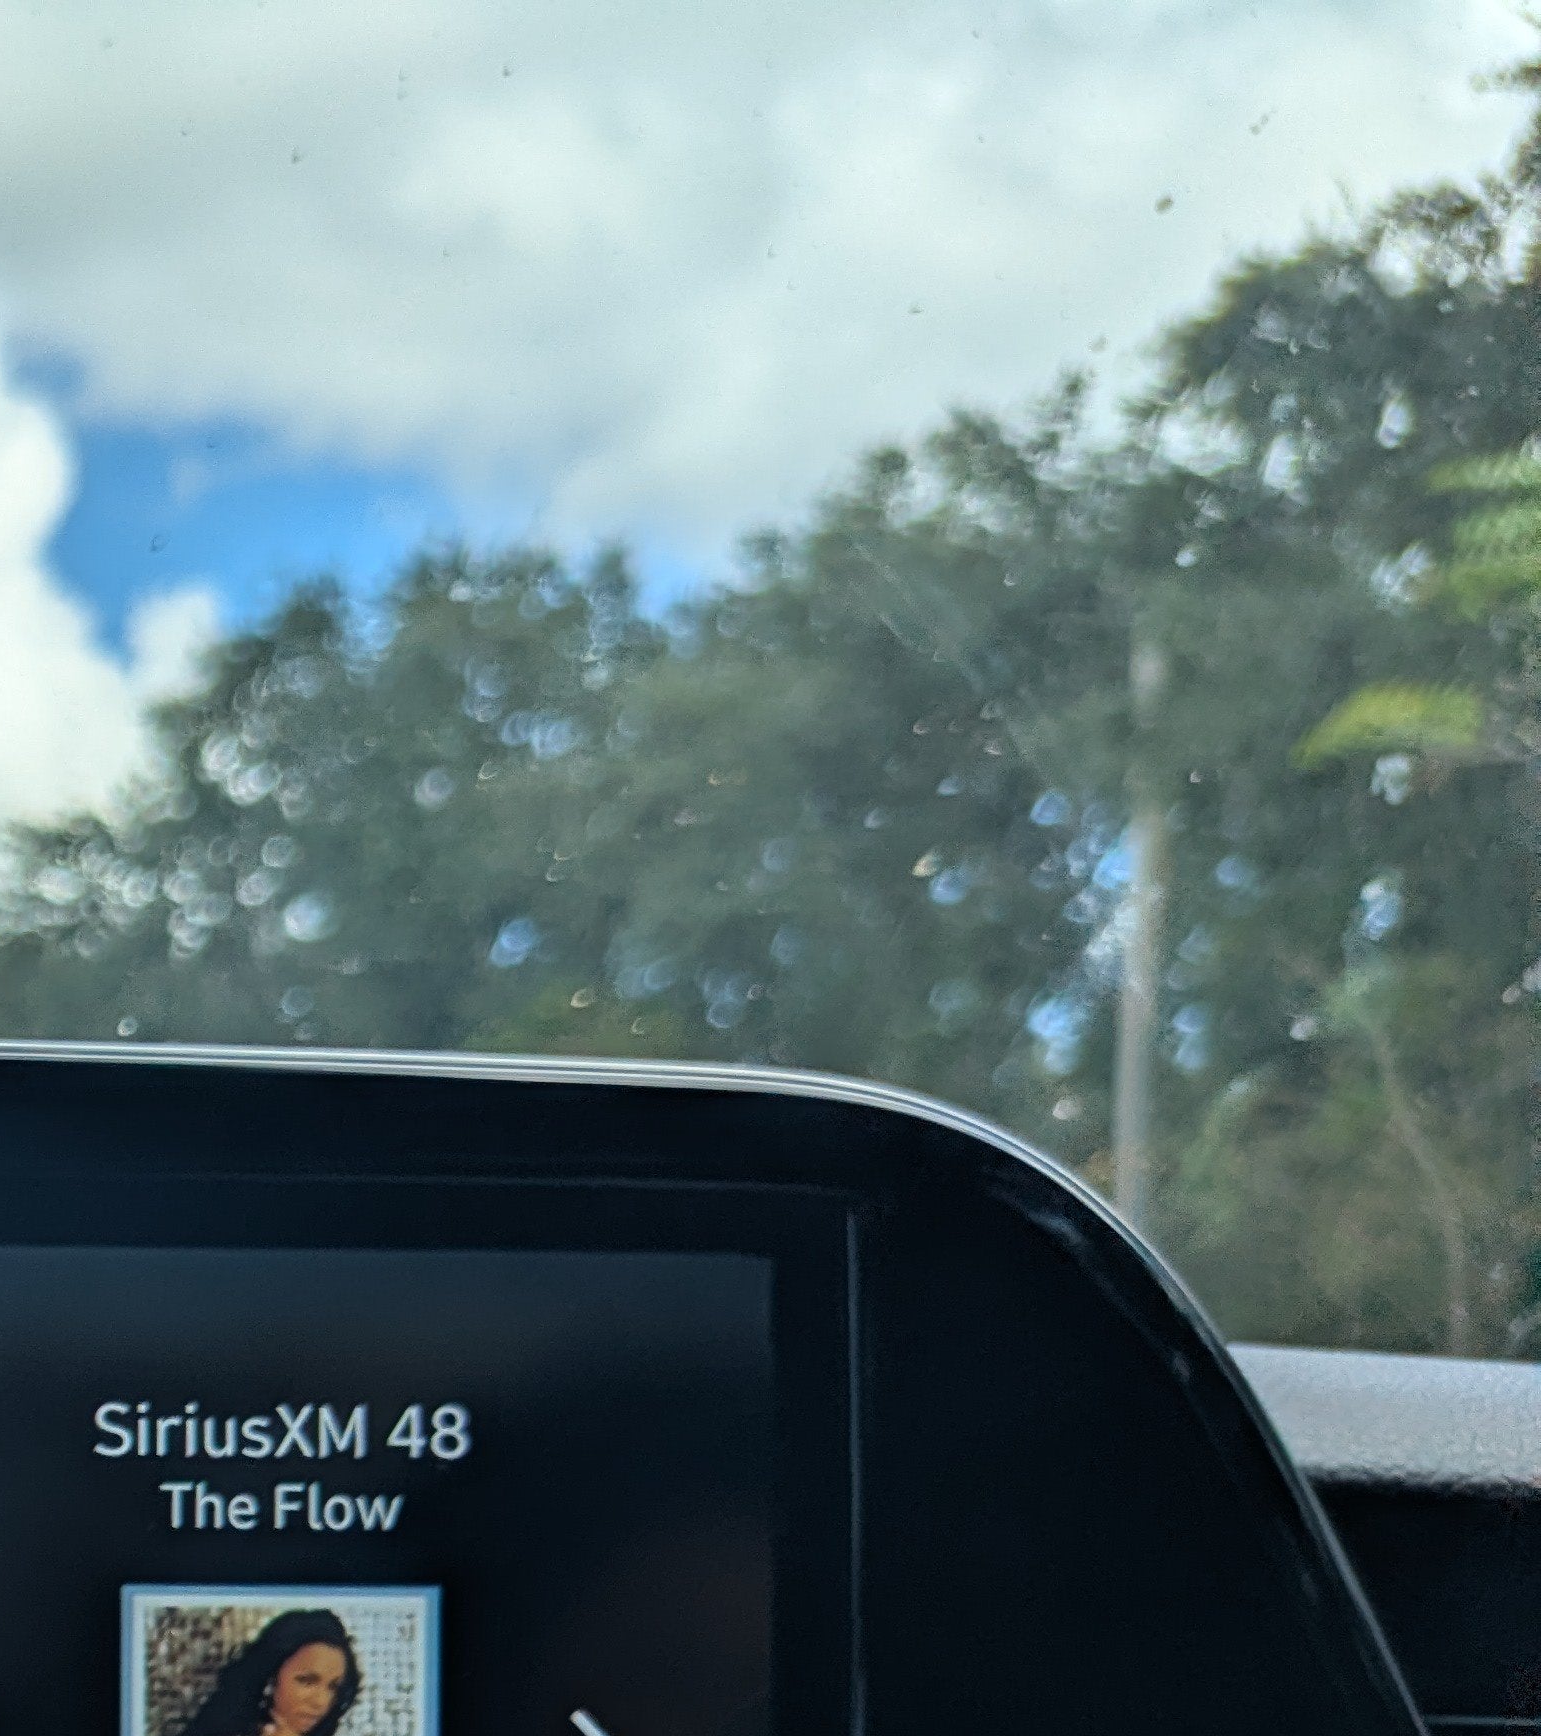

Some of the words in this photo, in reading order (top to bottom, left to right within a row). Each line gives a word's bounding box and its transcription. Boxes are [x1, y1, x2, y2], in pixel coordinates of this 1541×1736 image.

[92, 1401, 368, 1460] SiriusXM
[387, 1402, 473, 1461] 48
[159, 1481, 261, 1531] The
[274, 1482, 404, 1532] Flow
